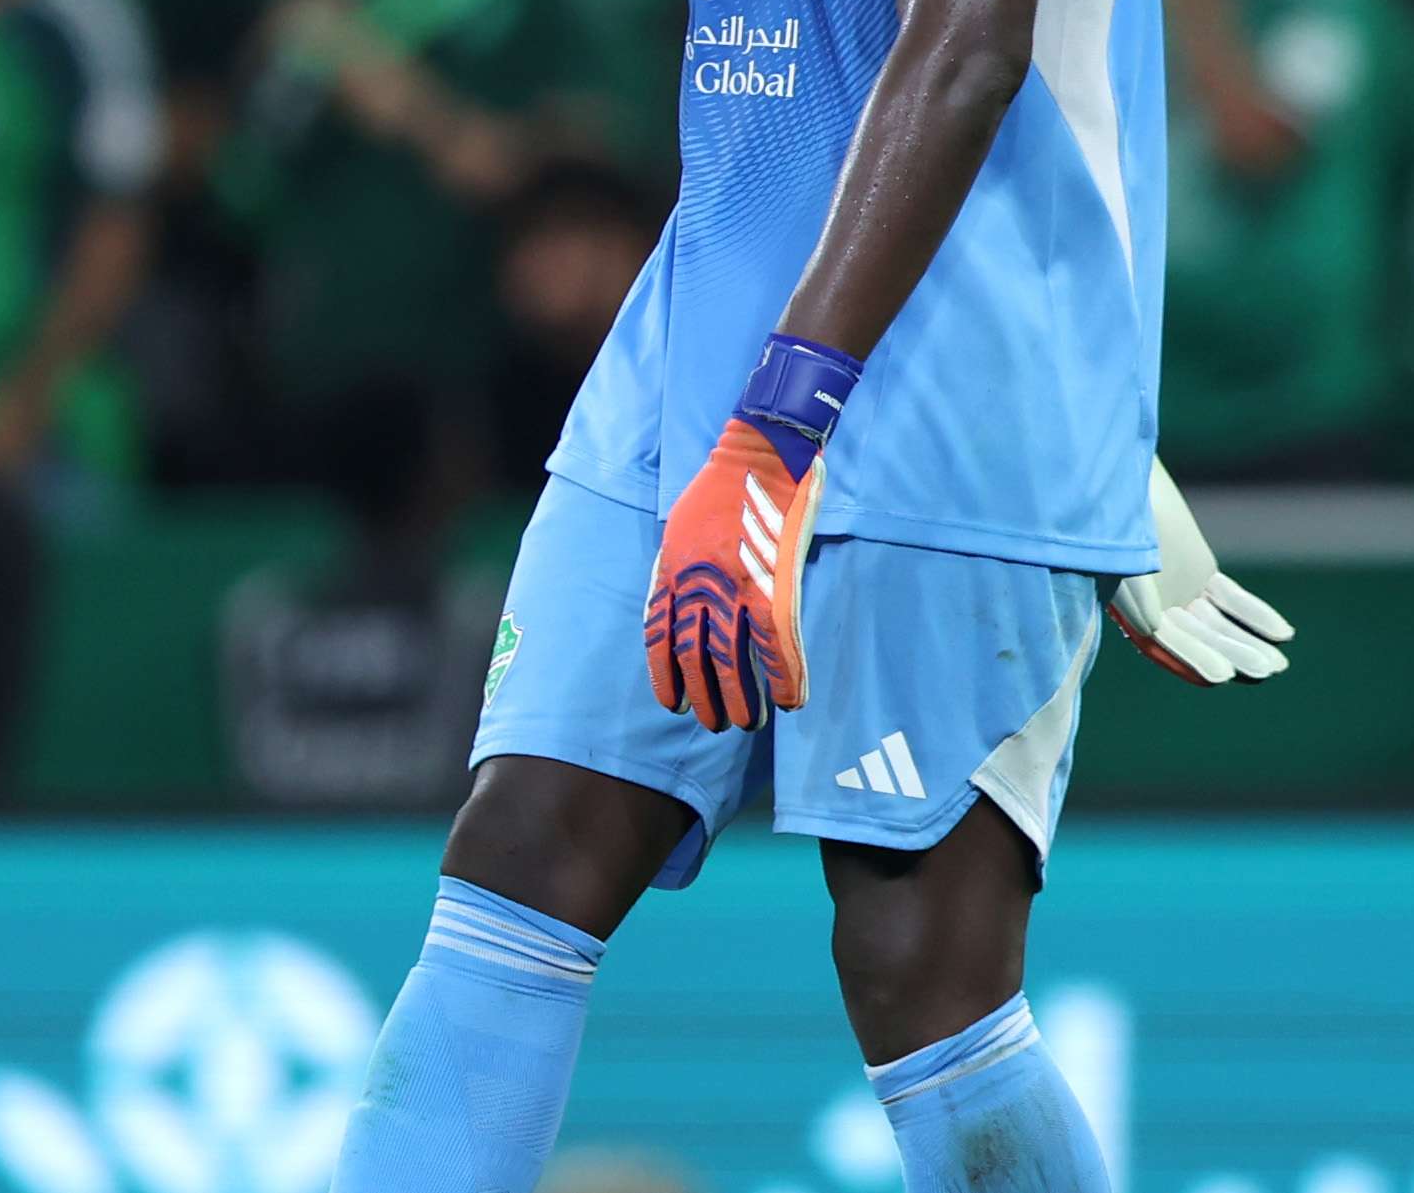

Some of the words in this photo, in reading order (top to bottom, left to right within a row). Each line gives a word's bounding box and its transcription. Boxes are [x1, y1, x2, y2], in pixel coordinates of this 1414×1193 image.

[685, 15, 744, 60] الأح
[742, 17, 799, 55] البحر
[694, 59, 796, 98] Global
